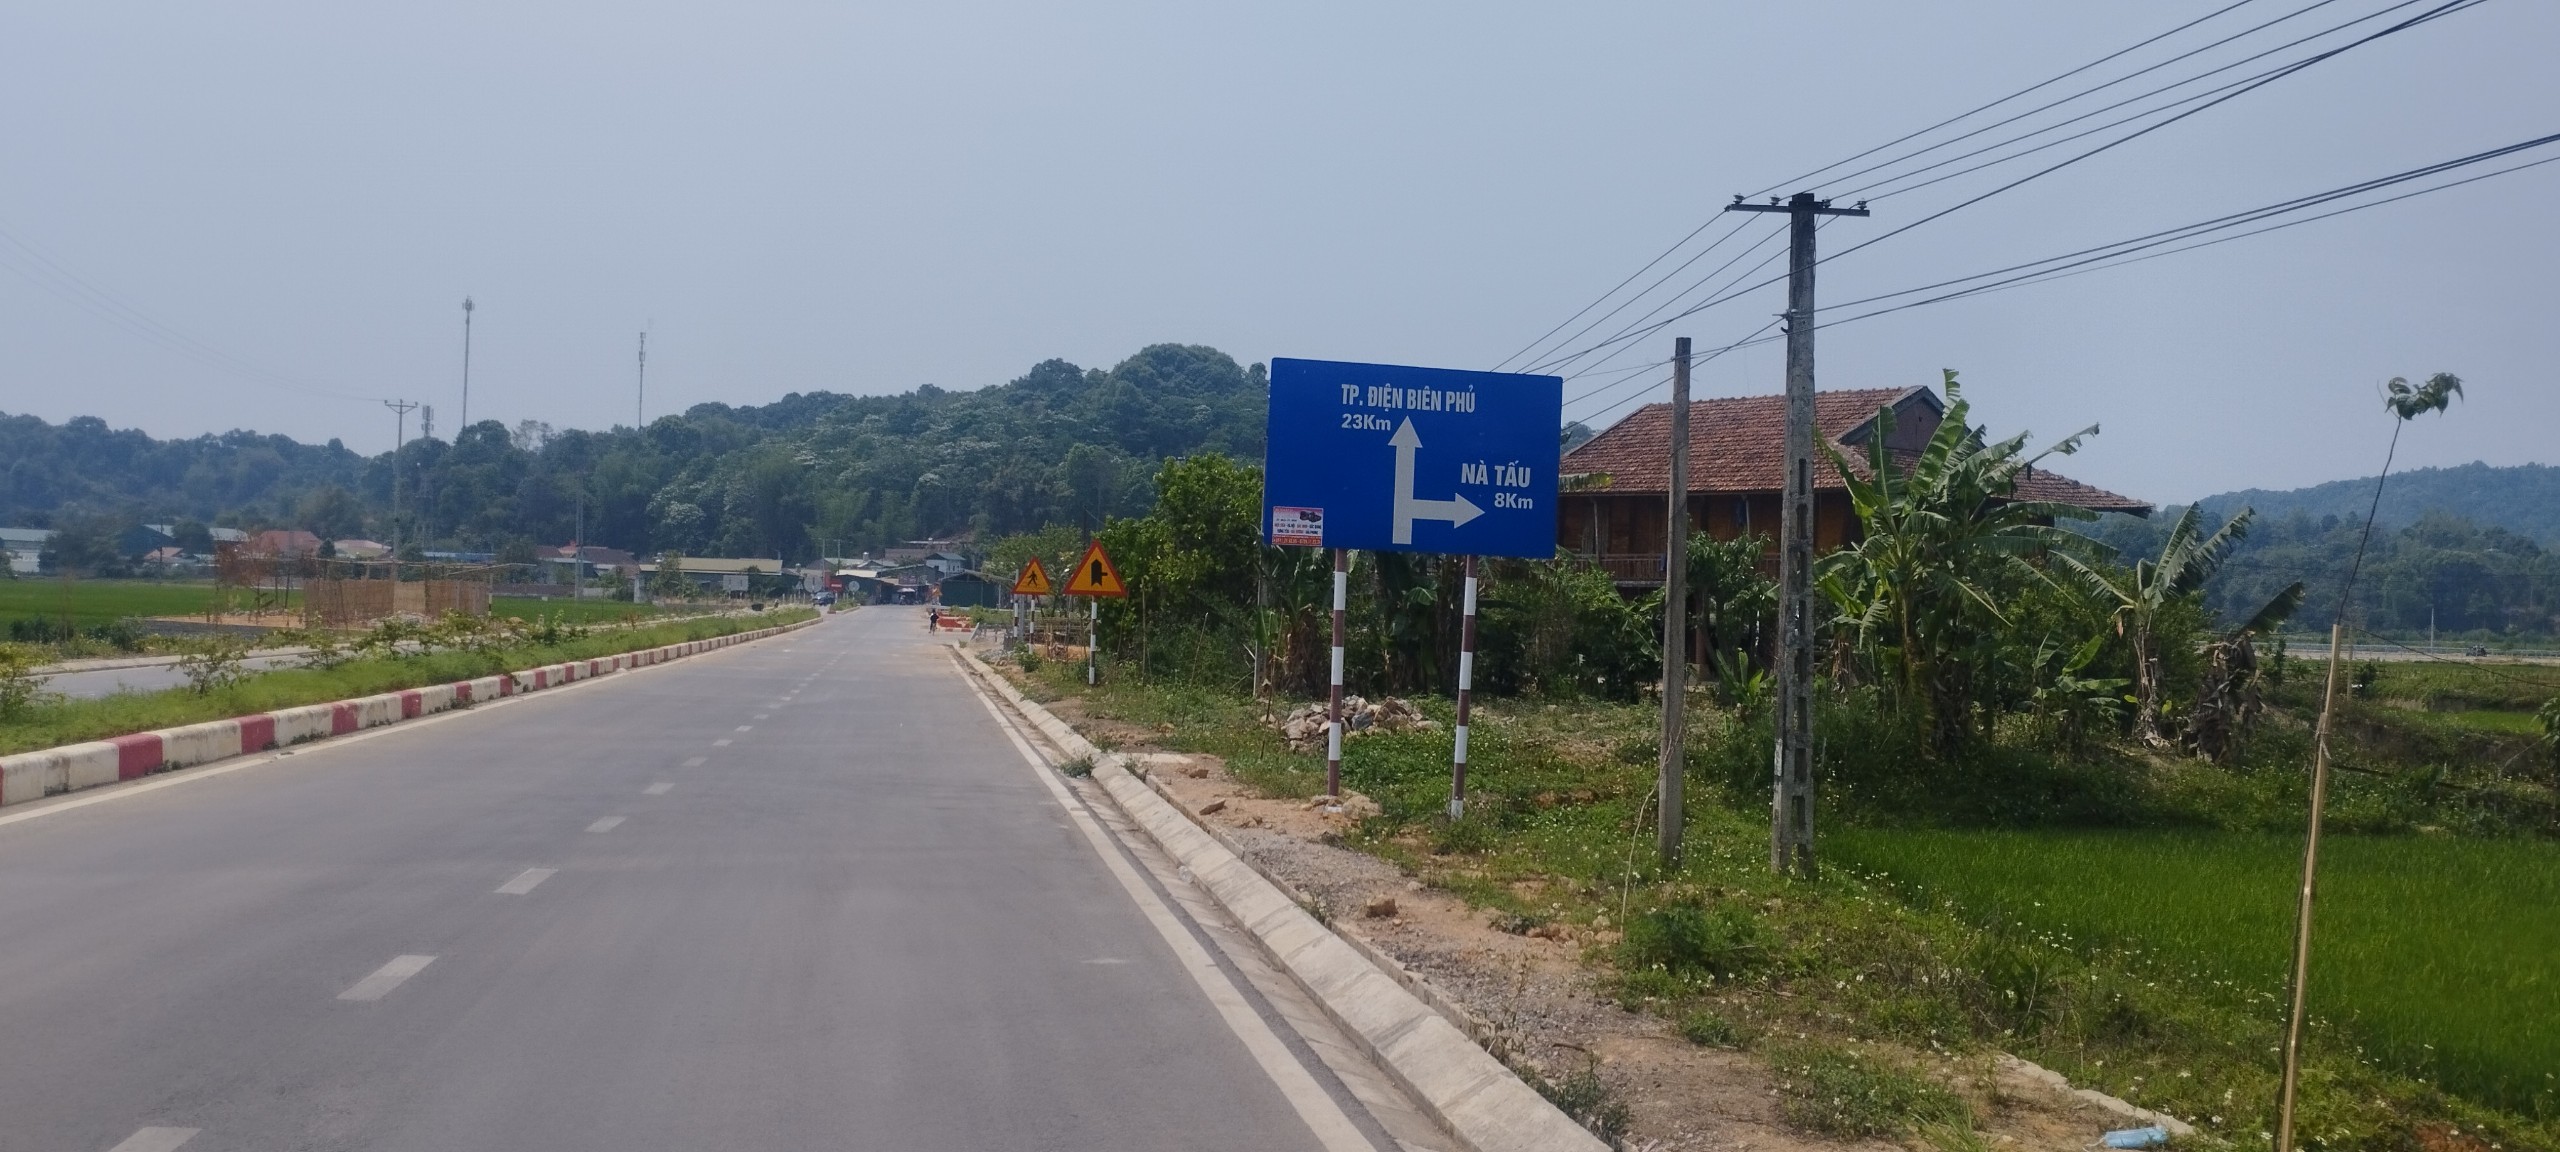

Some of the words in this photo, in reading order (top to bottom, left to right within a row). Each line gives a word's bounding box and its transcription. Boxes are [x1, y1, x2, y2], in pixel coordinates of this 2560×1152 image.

[1341, 383, 1363, 405] TP.
[1367, 383, 1402, 412] ĐIỆN
[1407, 386, 1442, 411] BIÊN
[1446, 384, 1476, 413] PHỦ
[1341, 413, 1391, 431] 23Km
[1461, 460, 1489, 485] NÀ
[1494, 460, 1531, 488] TẤU
[1494, 492, 1533, 509] 8Km
